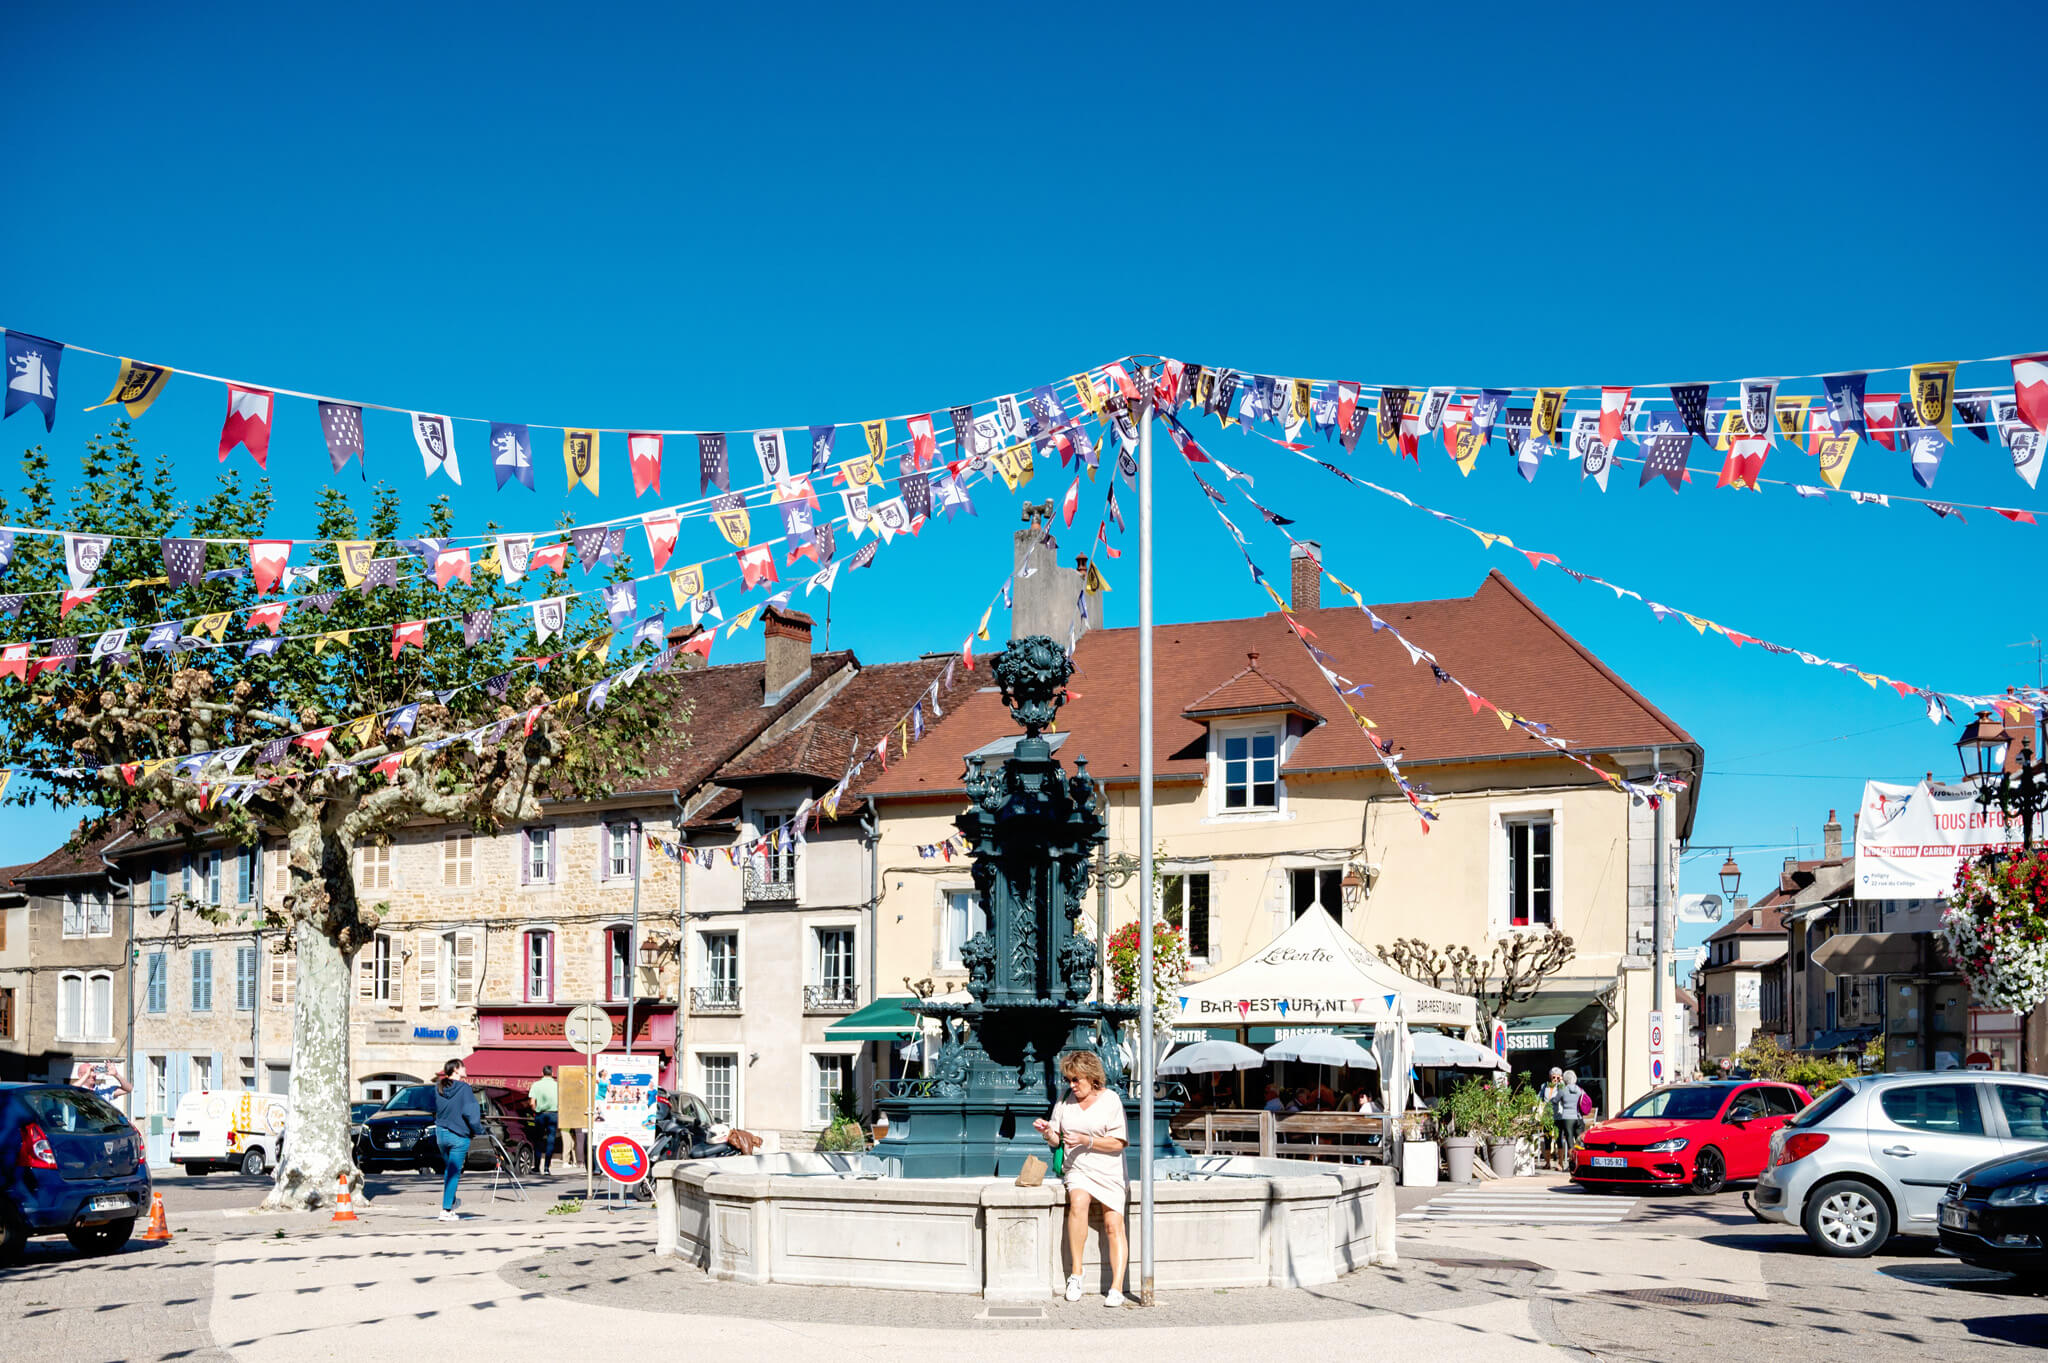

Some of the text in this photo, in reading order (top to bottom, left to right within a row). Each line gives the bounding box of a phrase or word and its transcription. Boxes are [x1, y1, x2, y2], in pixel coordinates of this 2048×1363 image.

[1917, 382, 1925, 400] JURA
[419, 422, 429, 438] JURA
[1933, 813, 1966, 831] TOUS
[1969, 812, 1985, 829] EN
[1923, 846, 1953, 857] CARDIO
[413, 1027, 445, 1039] Allianz
[503, 1022, 566, 1036] BOULANGE
